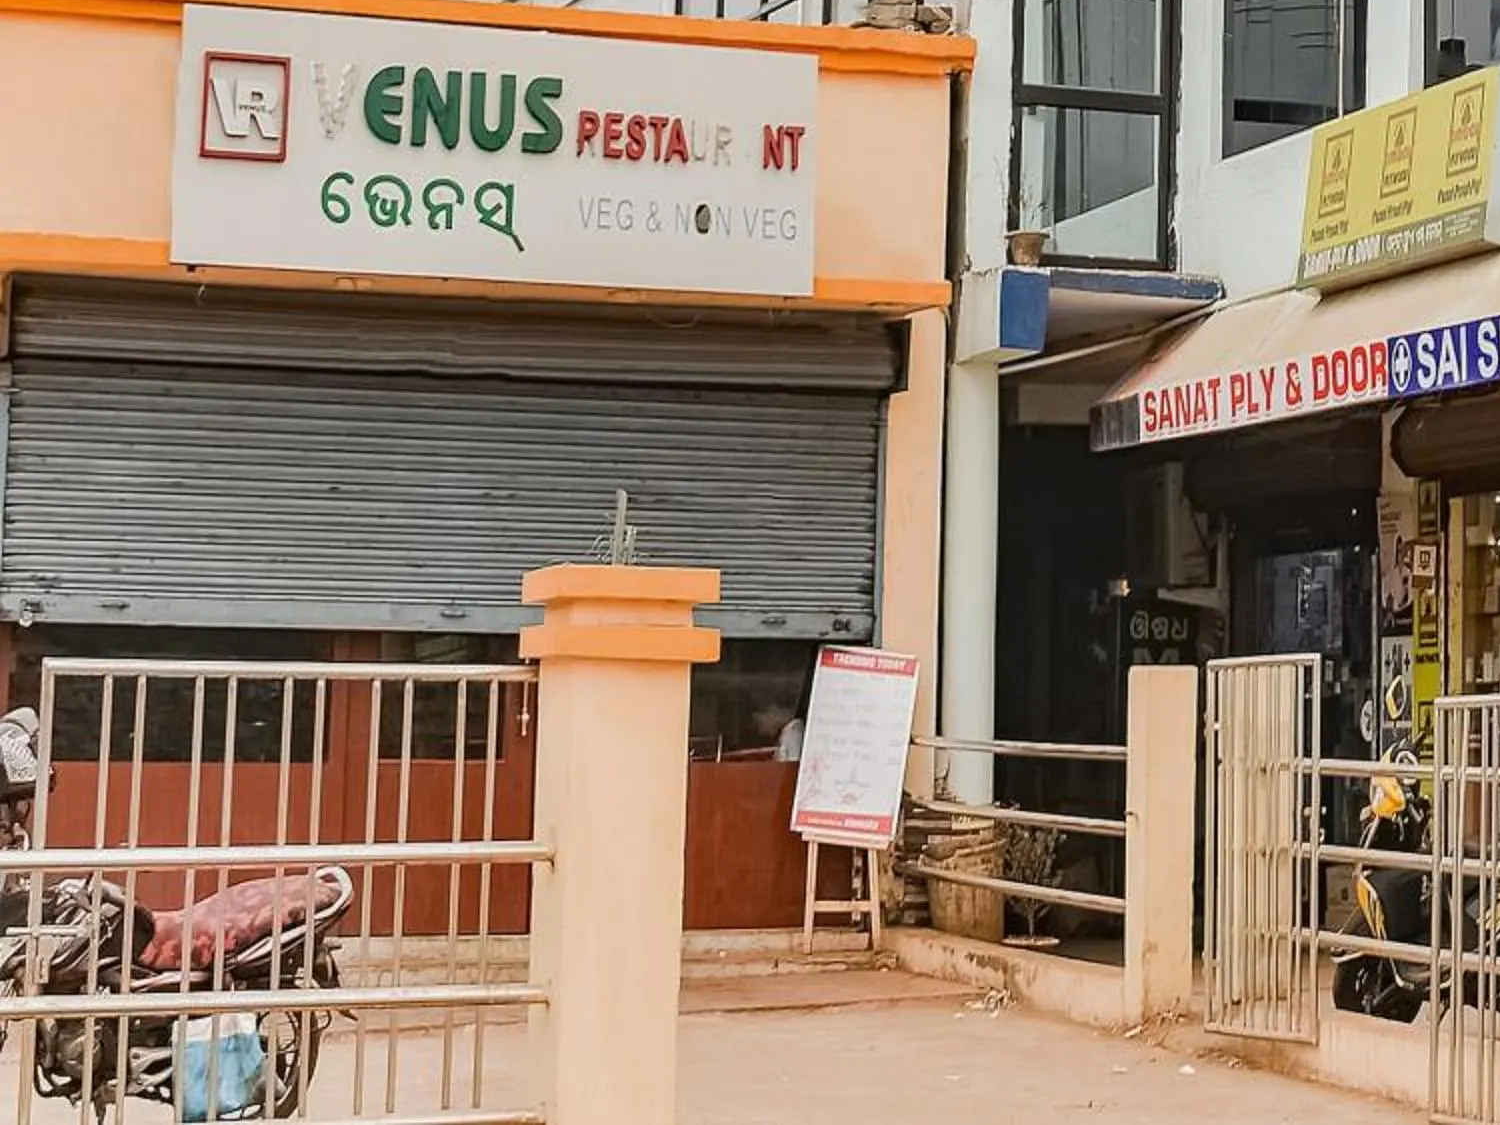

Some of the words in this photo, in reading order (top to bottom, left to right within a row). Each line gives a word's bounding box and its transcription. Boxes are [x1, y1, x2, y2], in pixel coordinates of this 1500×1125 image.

[579, 194, 634, 231] VEG
[646, 200, 662, 234] &
[674, 202, 732, 237] NON
[743, 207, 798, 241] VEG
[1143, 377, 1221, 434] SANAT
[1229, 366, 1276, 419] PLY
[1284, 359, 1302, 409] &
[1311, 341, 1387, 402] DOOR
[1416, 329, 1468, 389] SAI
